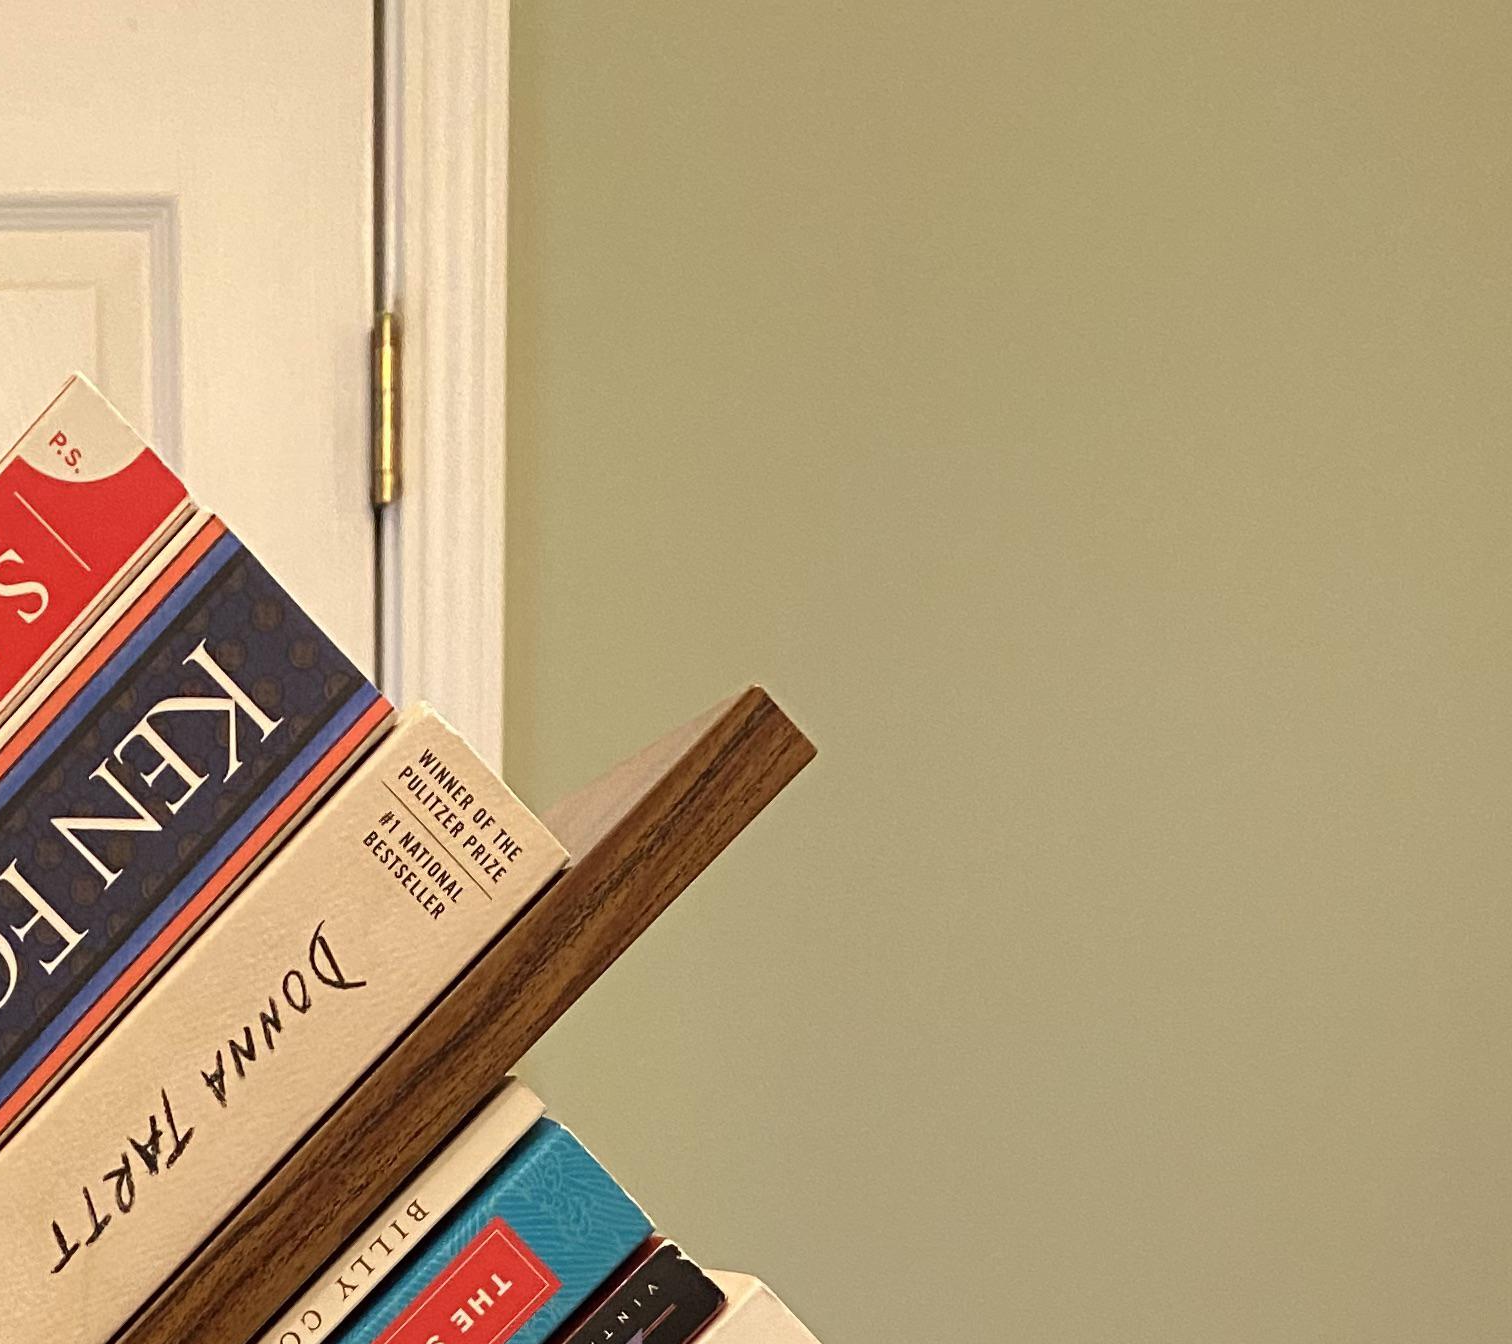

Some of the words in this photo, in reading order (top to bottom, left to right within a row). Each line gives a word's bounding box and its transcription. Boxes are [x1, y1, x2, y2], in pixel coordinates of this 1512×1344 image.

[48, 430, 82, 474] P.S.
[50, 638, 284, 890] KEN
[418, 748, 475, 811] WINNER
[472, 807, 496, 830] OF
[492, 828, 523, 863] THE
[362, 830, 446, 920] BESTSELLER
[378, 810, 401, 834] #1
[398, 831, 464, 904] NATIONAL
[398, 765, 465, 838] PULITZER
[462, 834, 507, 884] PRIZE
[201, 919, 367, 1106] DONNA
[50, 1088, 194, 1274] TARTT
[336, 1199, 430, 1302] BILLY
[450, 1273, 513, 1333] THE
